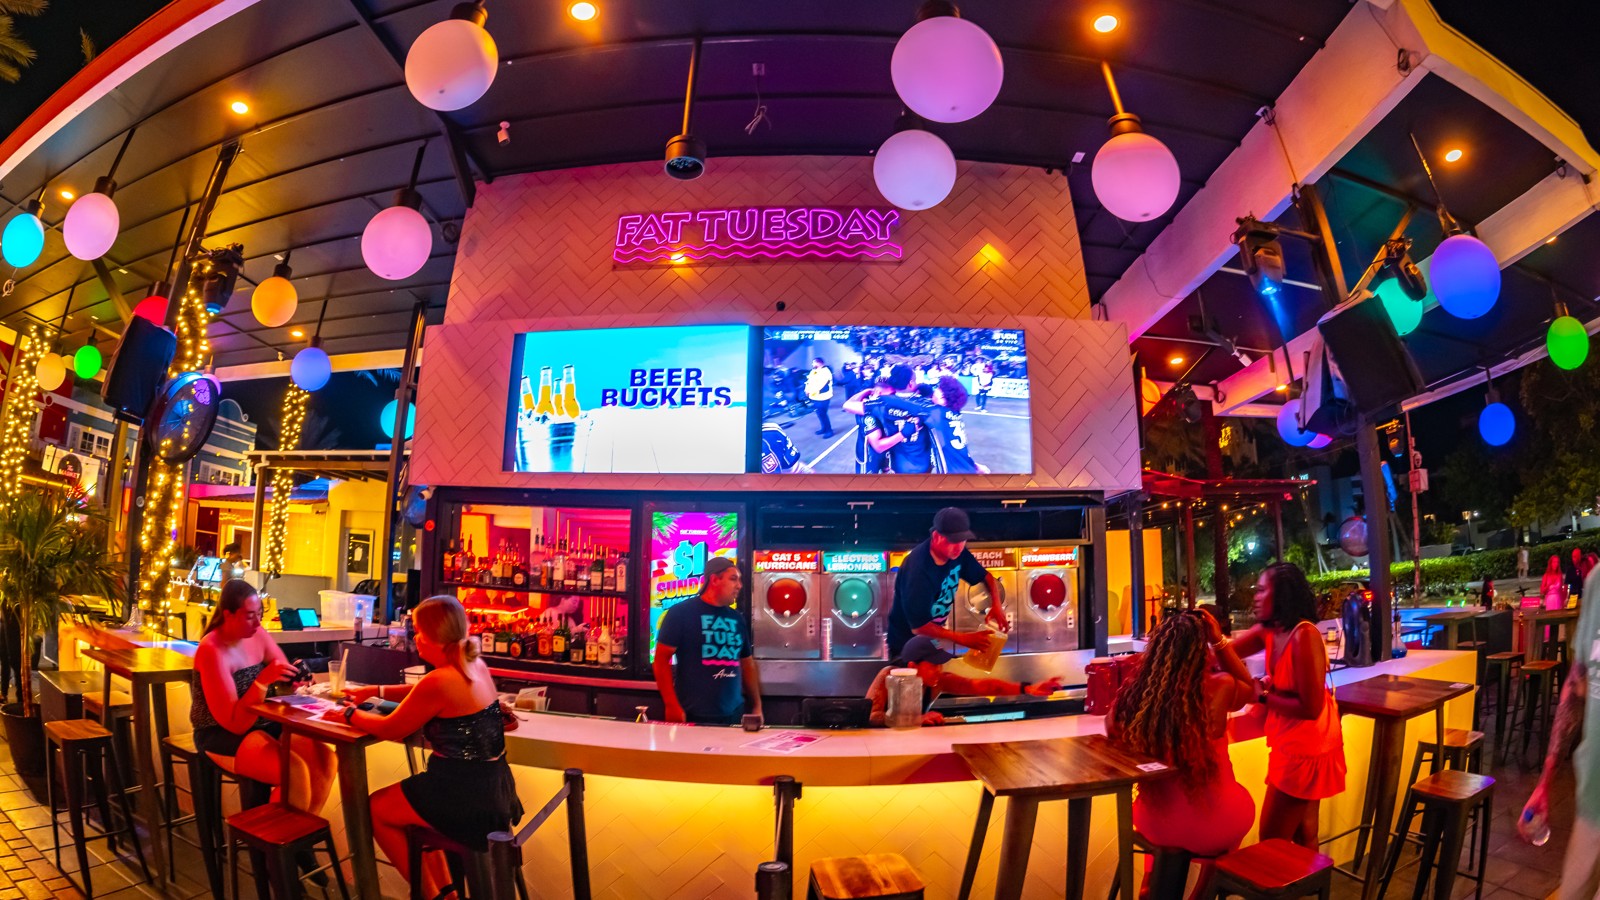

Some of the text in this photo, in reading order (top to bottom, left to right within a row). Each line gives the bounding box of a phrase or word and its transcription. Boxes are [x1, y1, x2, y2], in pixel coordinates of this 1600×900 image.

[615, 207, 899, 246] FAT TUESDAY
[629, 367, 703, 387] BEER
[601, 386, 732, 407] BUCKETS
[673, 540, 706, 580] $1
[756, 561, 817, 570] HURRICANE
[771, 553, 801, 562] CAT 5
[831, 554, 879, 563] ELECTRIC
[1021, 553, 1076, 563] STRAWBERRY
[827, 562, 882, 571] LEMONADE
[701, 614, 737, 633] FAT
[701, 630, 742, 647] TUES
[701, 644, 741, 660] DAY
